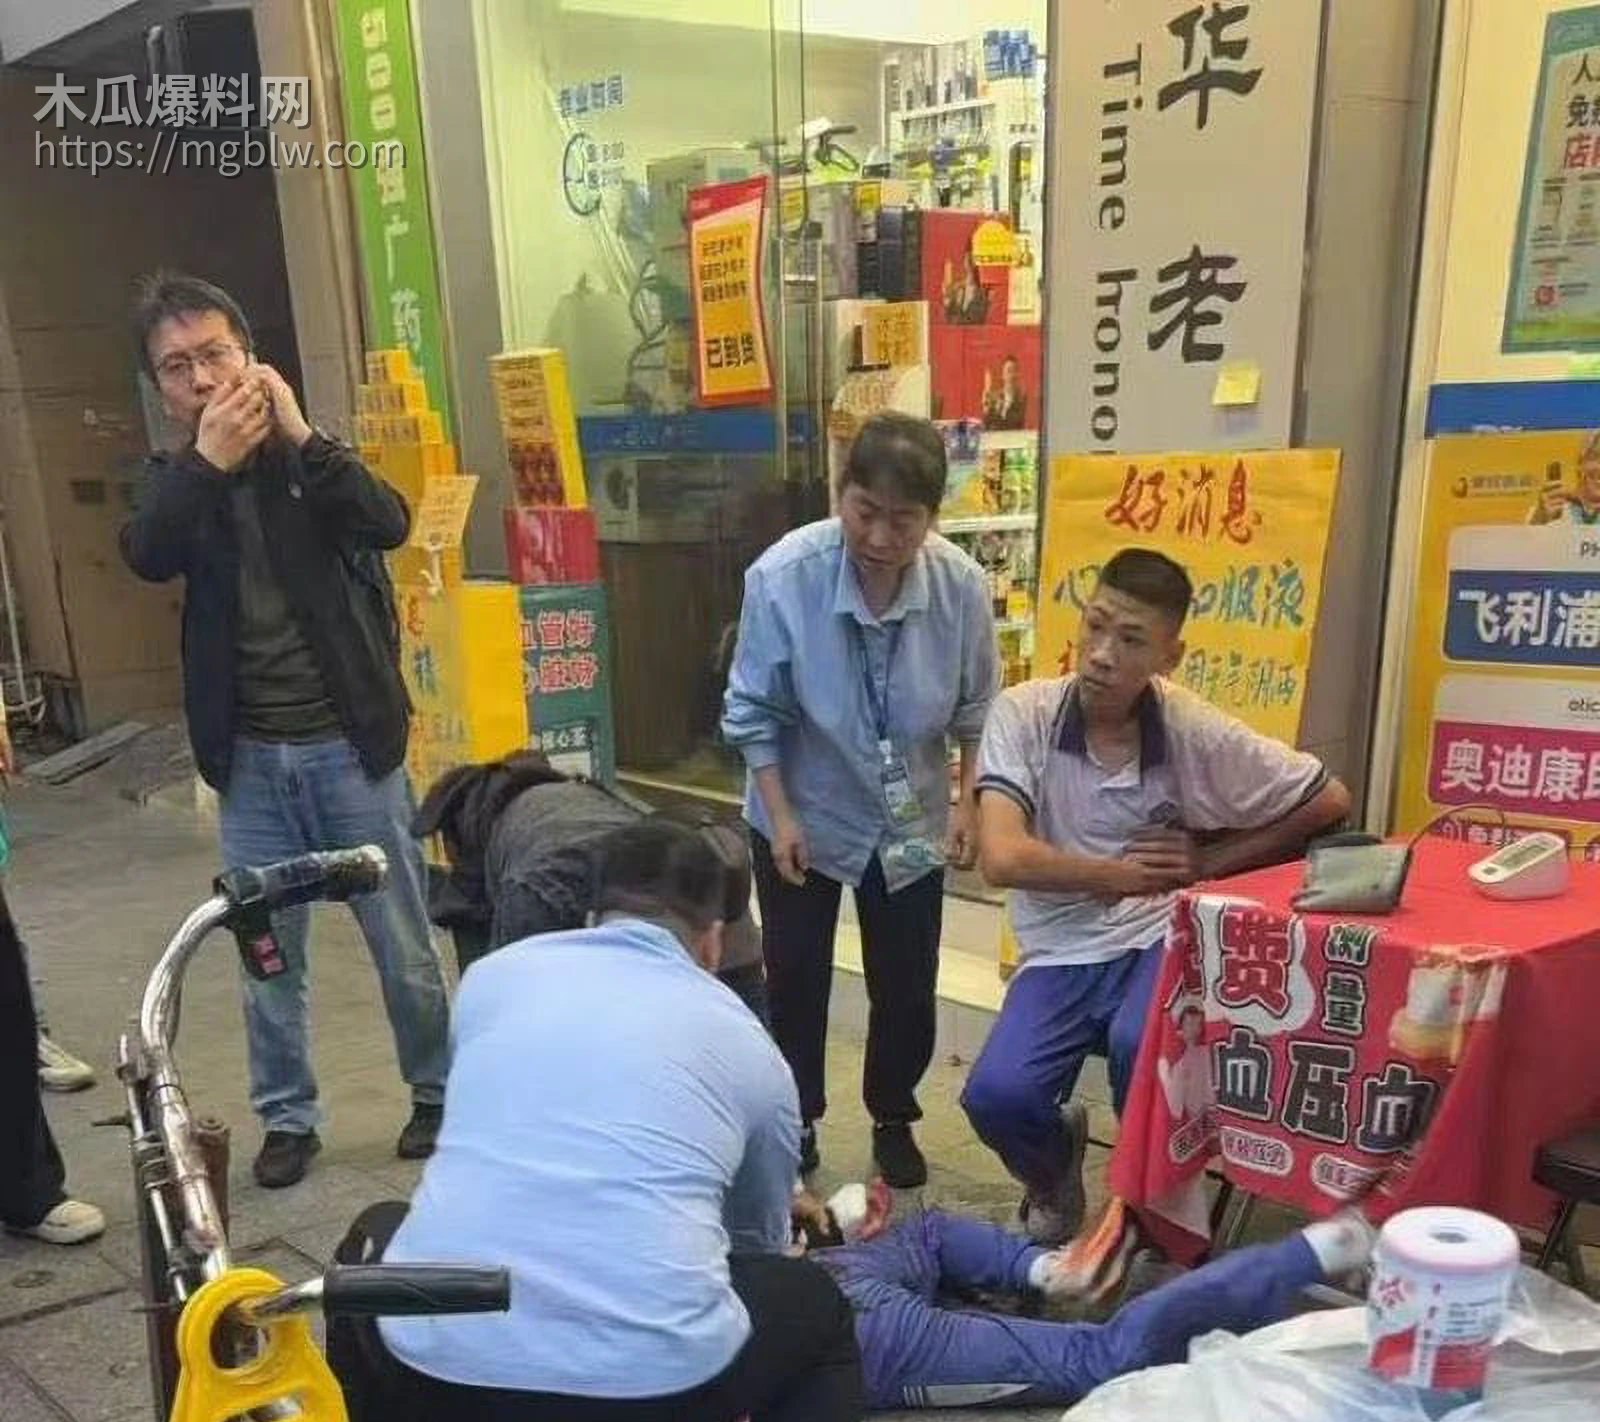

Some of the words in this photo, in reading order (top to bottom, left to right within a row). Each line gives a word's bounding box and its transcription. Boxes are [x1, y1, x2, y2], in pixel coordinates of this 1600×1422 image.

[1571, 53, 1600, 85] 人
[1099, 42, 1142, 231] Time
[1563, 133, 1600, 169] 店
[1090, 268, 1138, 454] hono
[1105, 458, 1263, 545] 好消息
[1459, 587, 1600, 649] 飞利浦
[1213, 1028, 1440, 1154] 血压血
